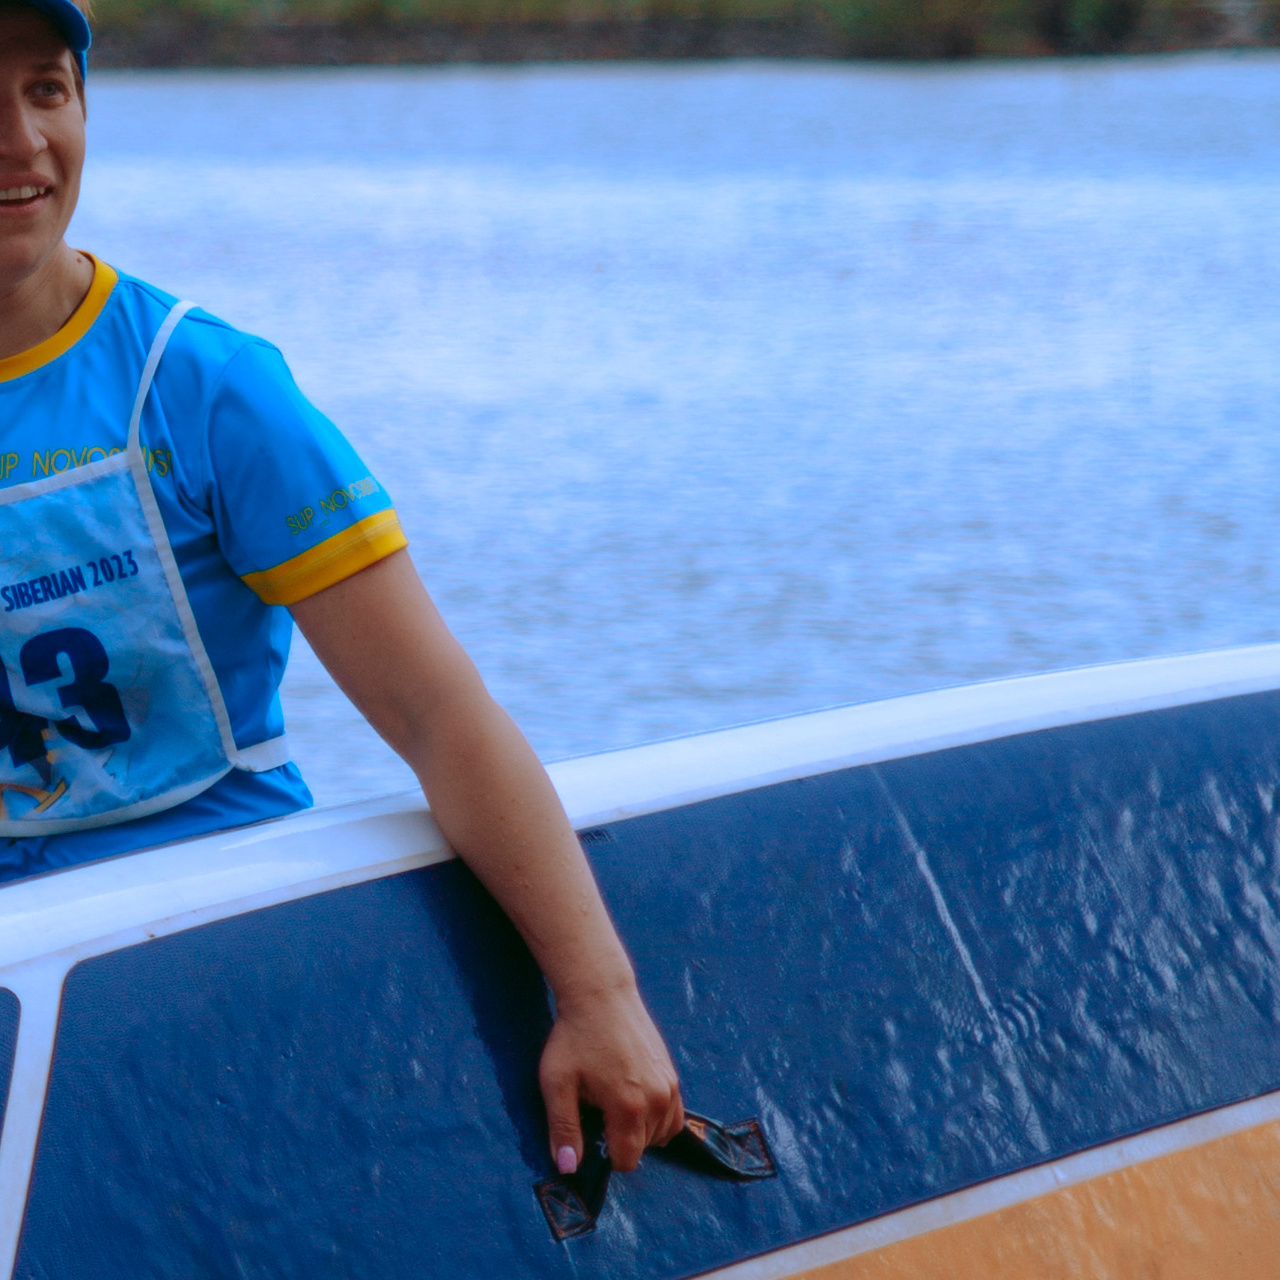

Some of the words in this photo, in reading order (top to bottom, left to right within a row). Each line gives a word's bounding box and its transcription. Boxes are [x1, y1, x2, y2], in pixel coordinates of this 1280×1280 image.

[286, 507, 314, 535] SUP
[0, 566, 87, 612] SIBERIAN
[87, 550, 139, 588] 2023
